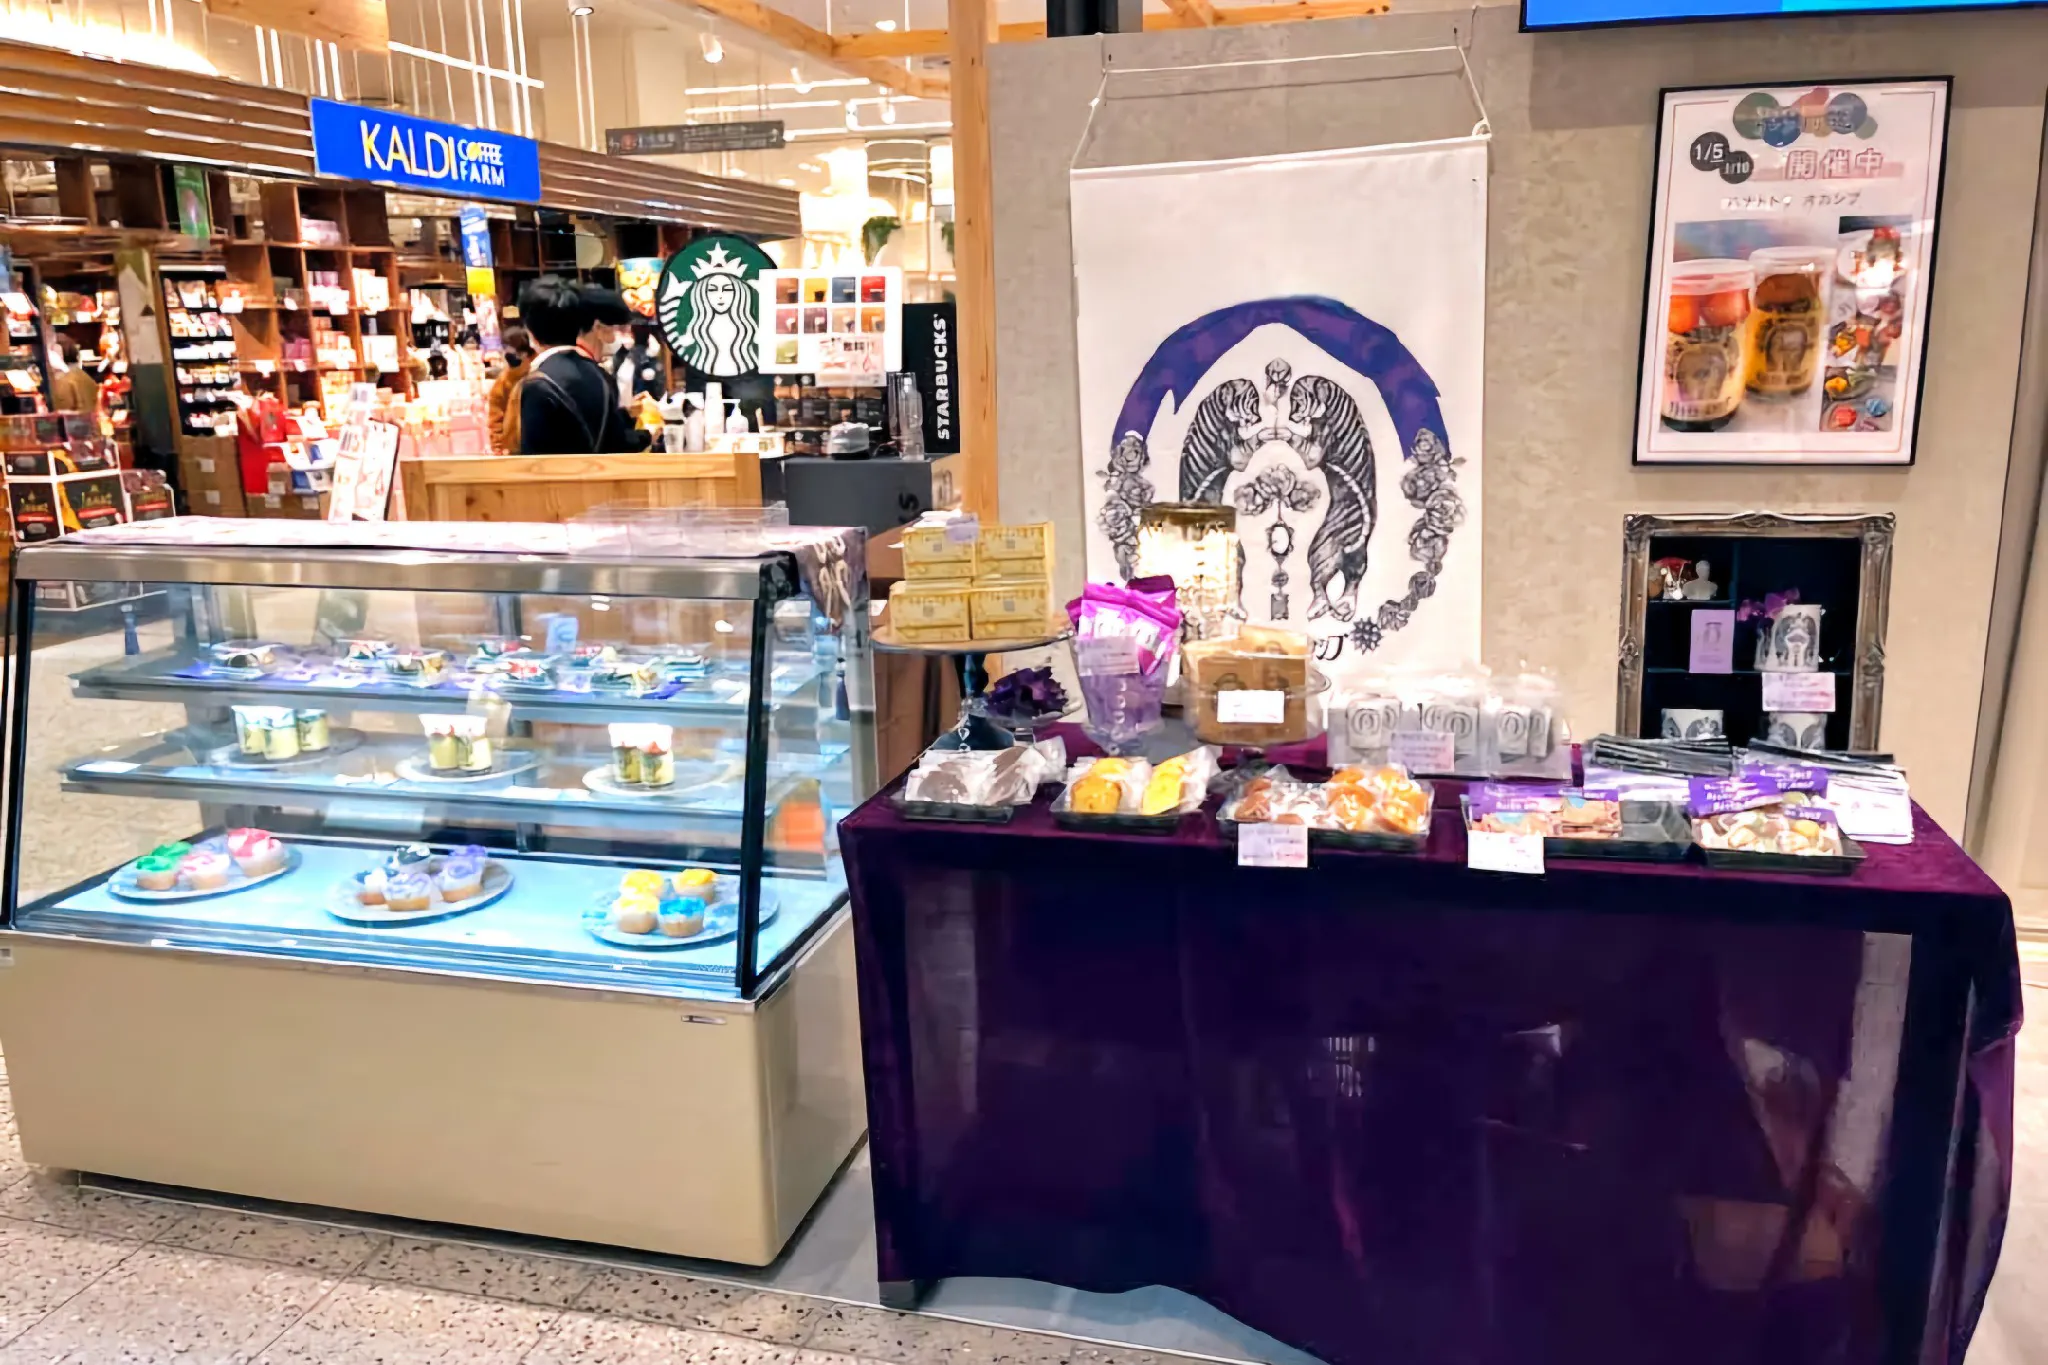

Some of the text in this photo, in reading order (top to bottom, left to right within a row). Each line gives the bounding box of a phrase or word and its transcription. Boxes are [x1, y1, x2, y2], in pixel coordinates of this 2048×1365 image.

[360, 119, 458, 180] KALDI
[1784, 147, 1884, 180] 開催中
[460, 160, 505, 187] FARM
[933, 316, 950, 440] STARBUCKS
